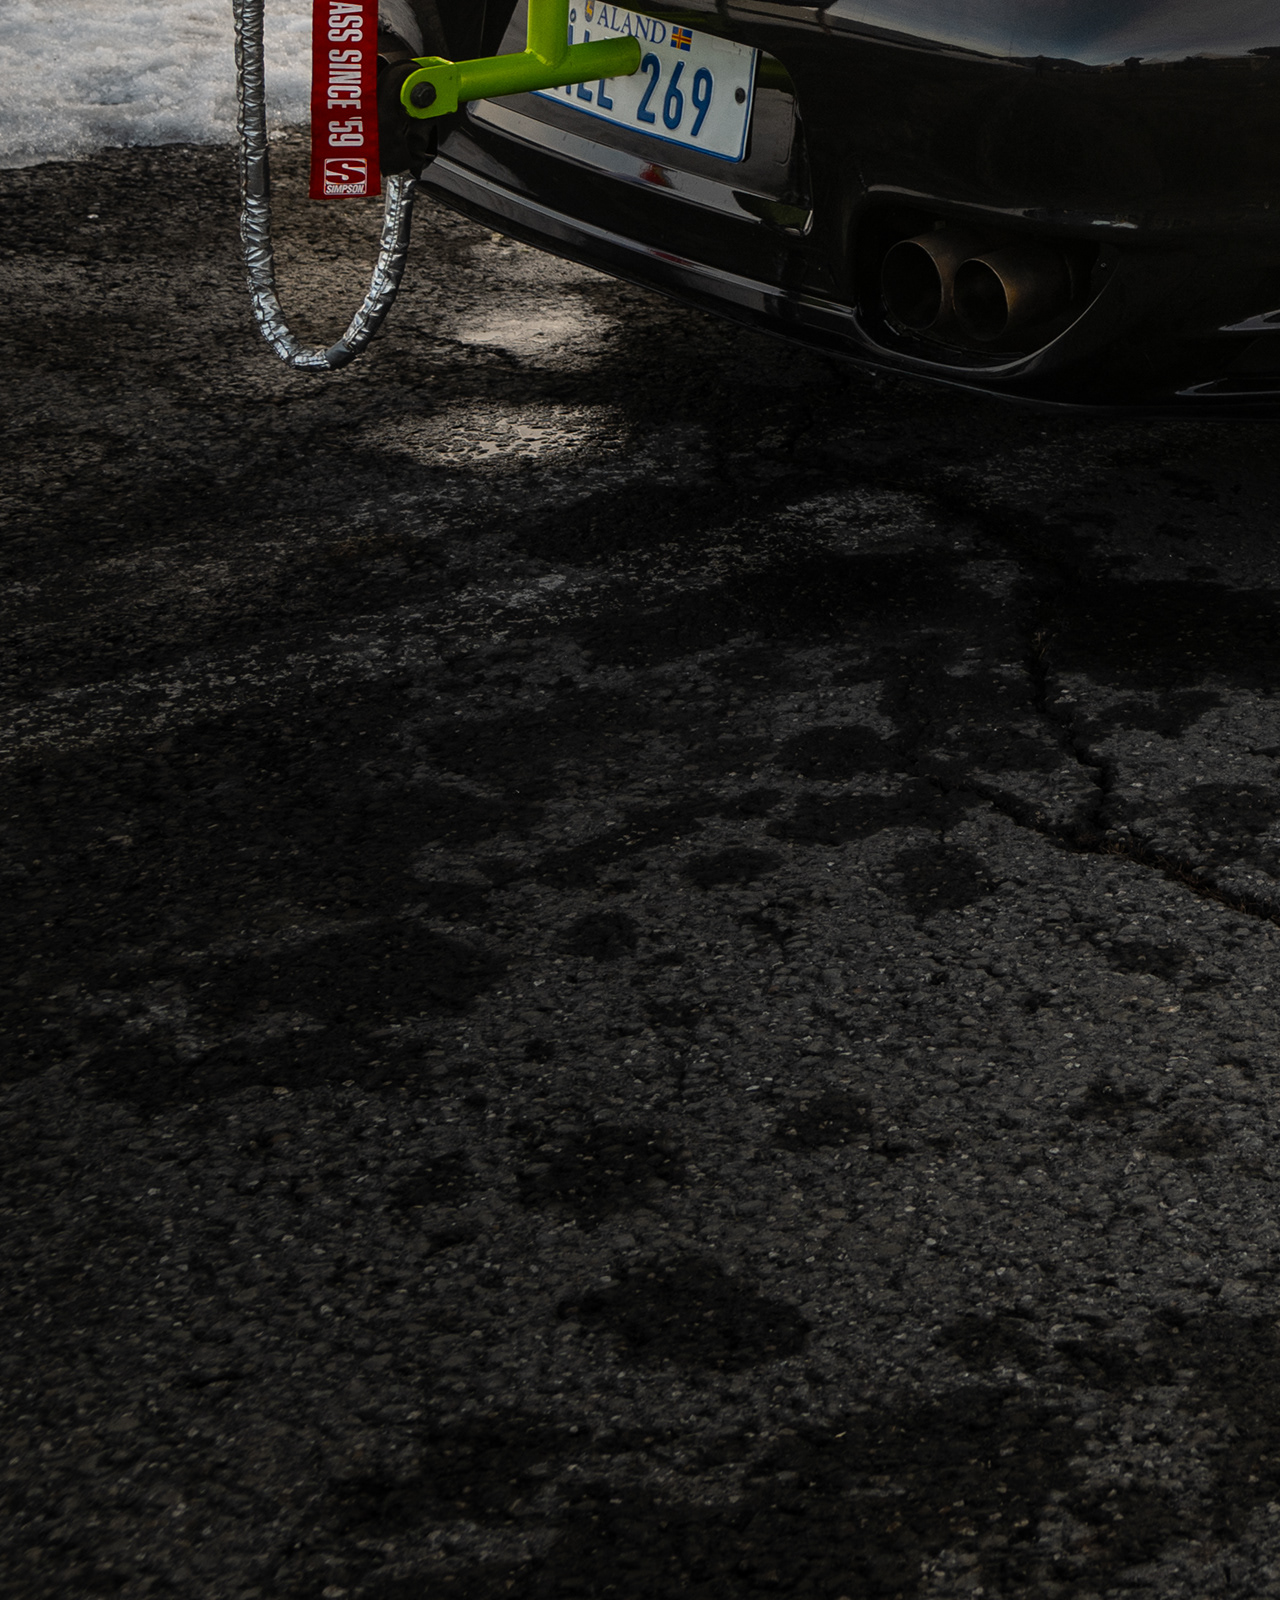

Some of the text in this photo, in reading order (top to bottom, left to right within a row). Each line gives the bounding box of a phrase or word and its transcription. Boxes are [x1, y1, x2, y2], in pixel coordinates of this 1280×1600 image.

[328, 2, 364, 43] ASS
[327, 49, 363, 110] SINCE
[636, 52, 714, 138] 269
[326, 184, 365, 194] SIMPSON
